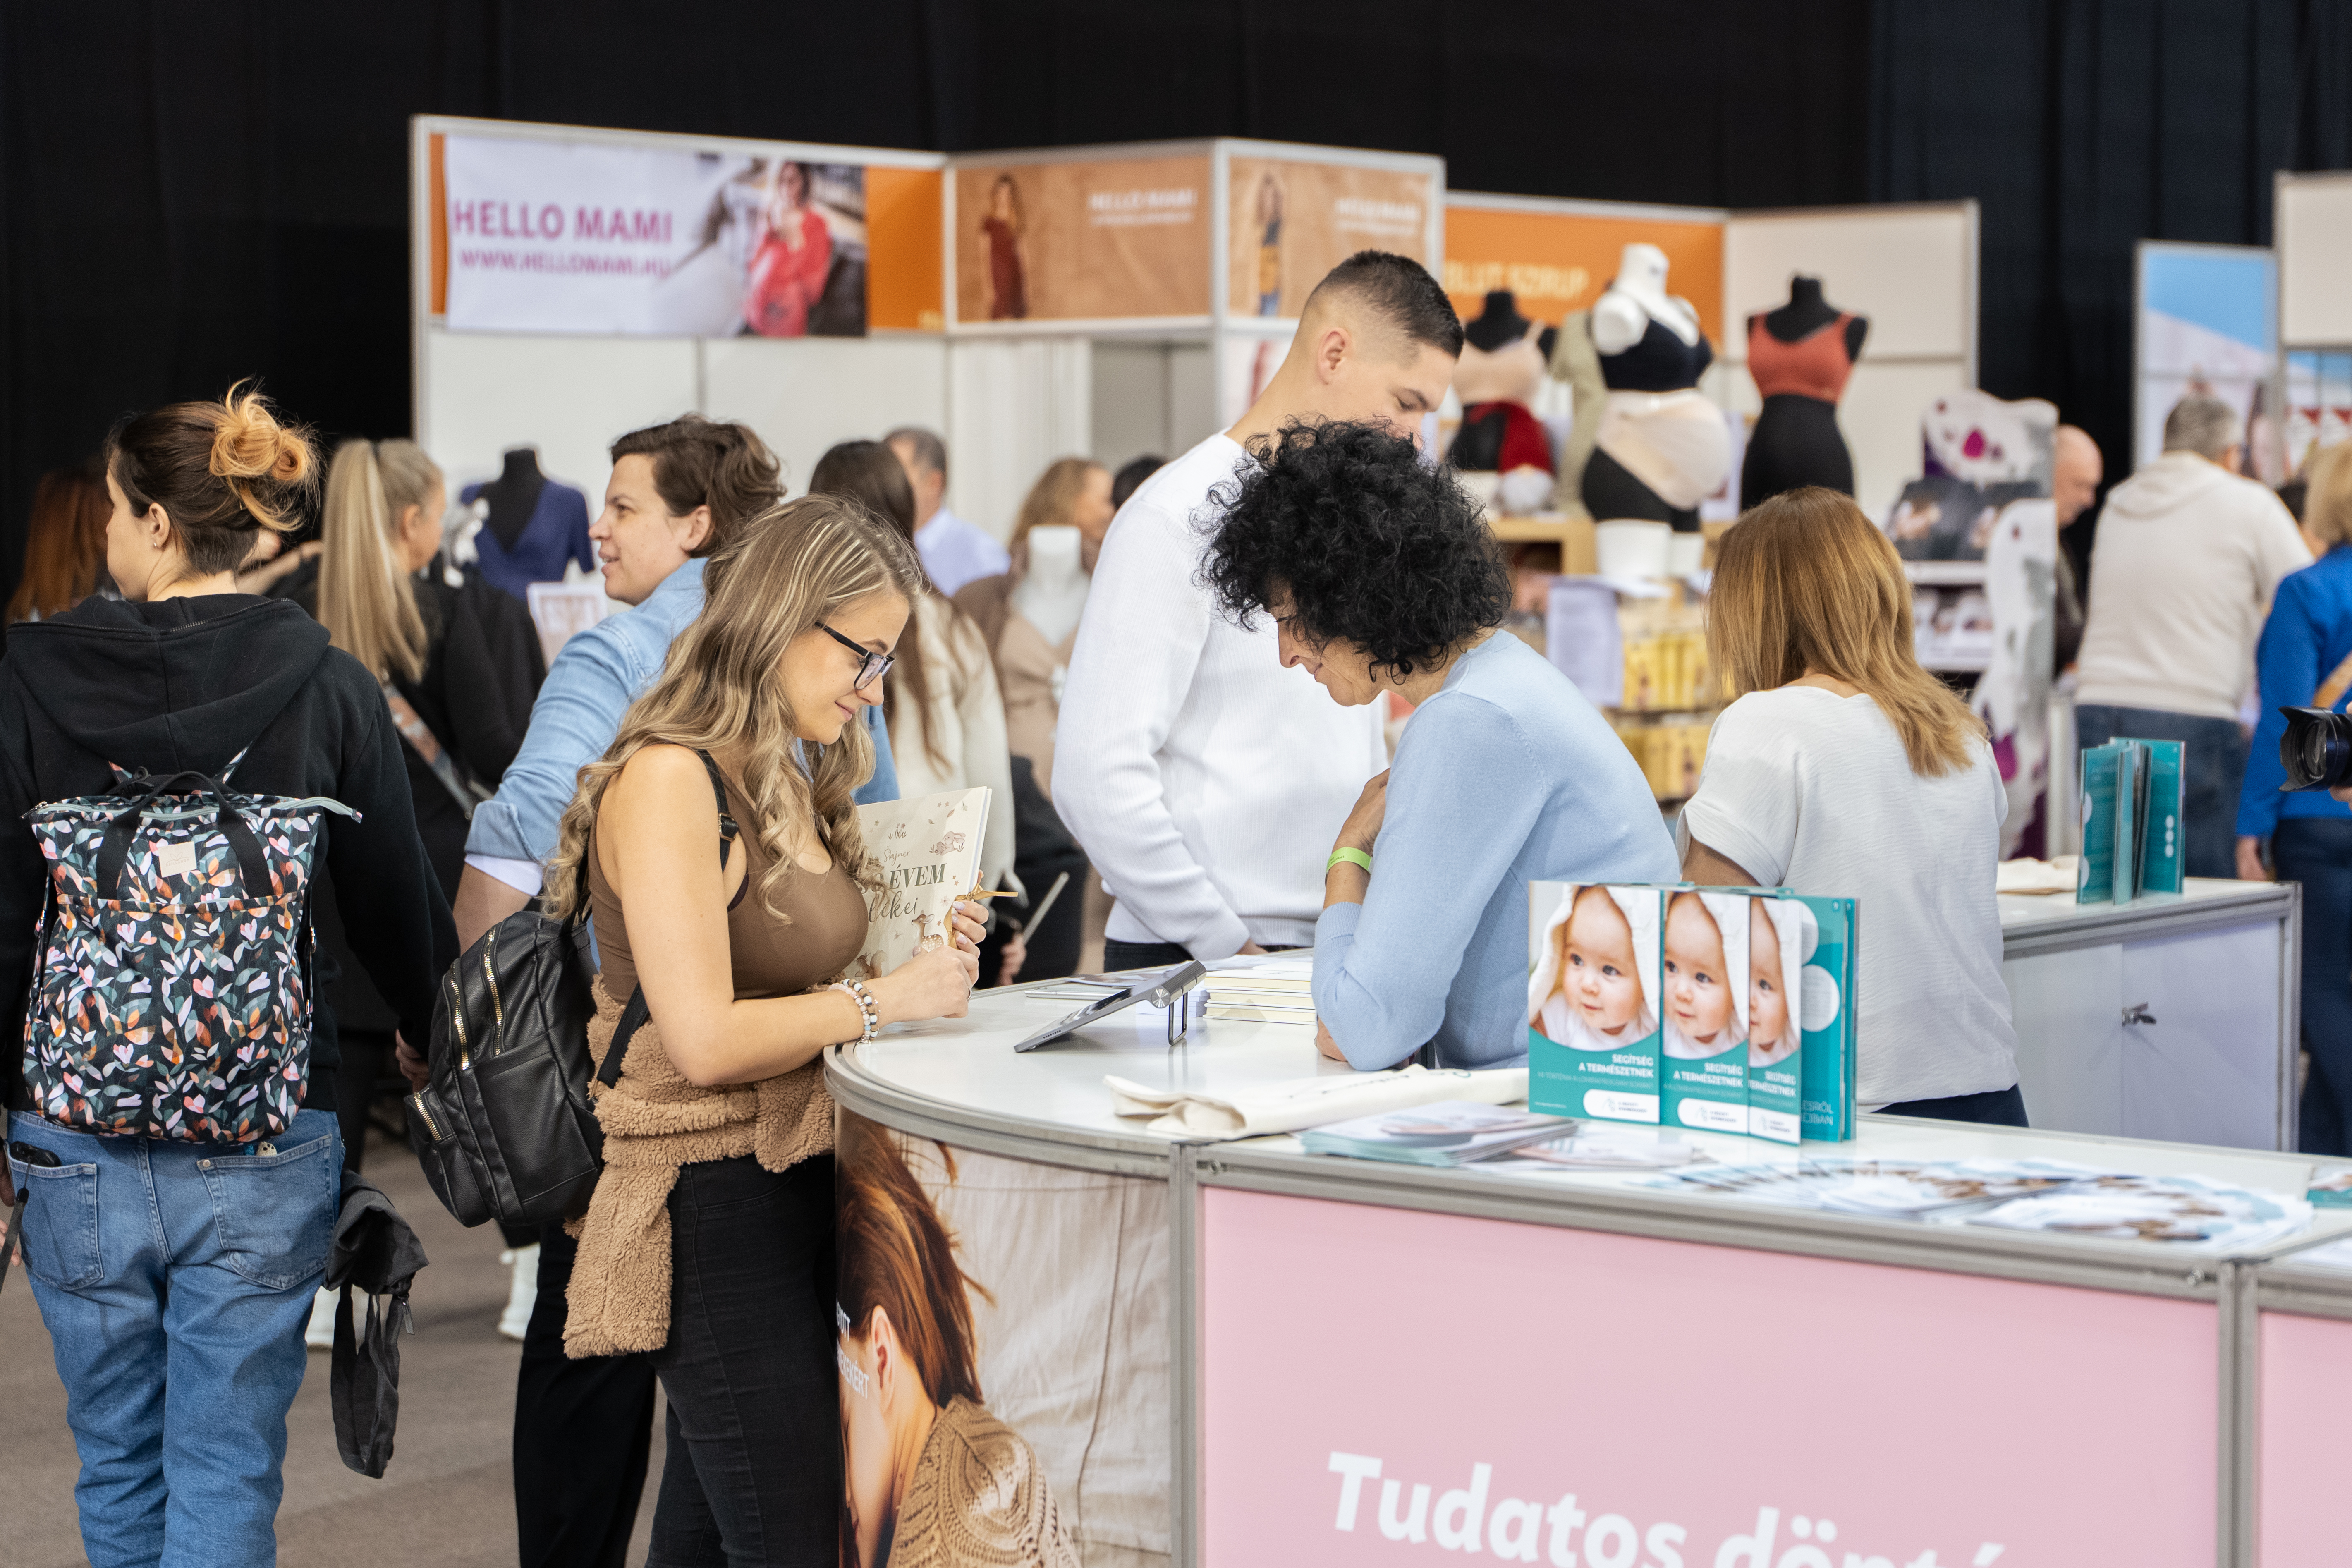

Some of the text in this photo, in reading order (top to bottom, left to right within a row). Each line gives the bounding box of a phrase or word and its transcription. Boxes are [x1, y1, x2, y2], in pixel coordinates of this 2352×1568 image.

[455, 200, 673, 243] HELLO MAMI
[884, 846, 910, 866] Štajner
[890, 864, 947, 890] ÉVEM
[1612, 1053, 1654, 1066] SEGÍTSÉG
[1704, 1062, 1743, 1076] SEGÍTSÉG
[1578, 1062, 1654, 1078] A TERMÉSZETNEK
[1673, 1070, 1743, 1088] A TERMÉSZETNEK
[1328, 1451, 1688, 1568] Tudatos
